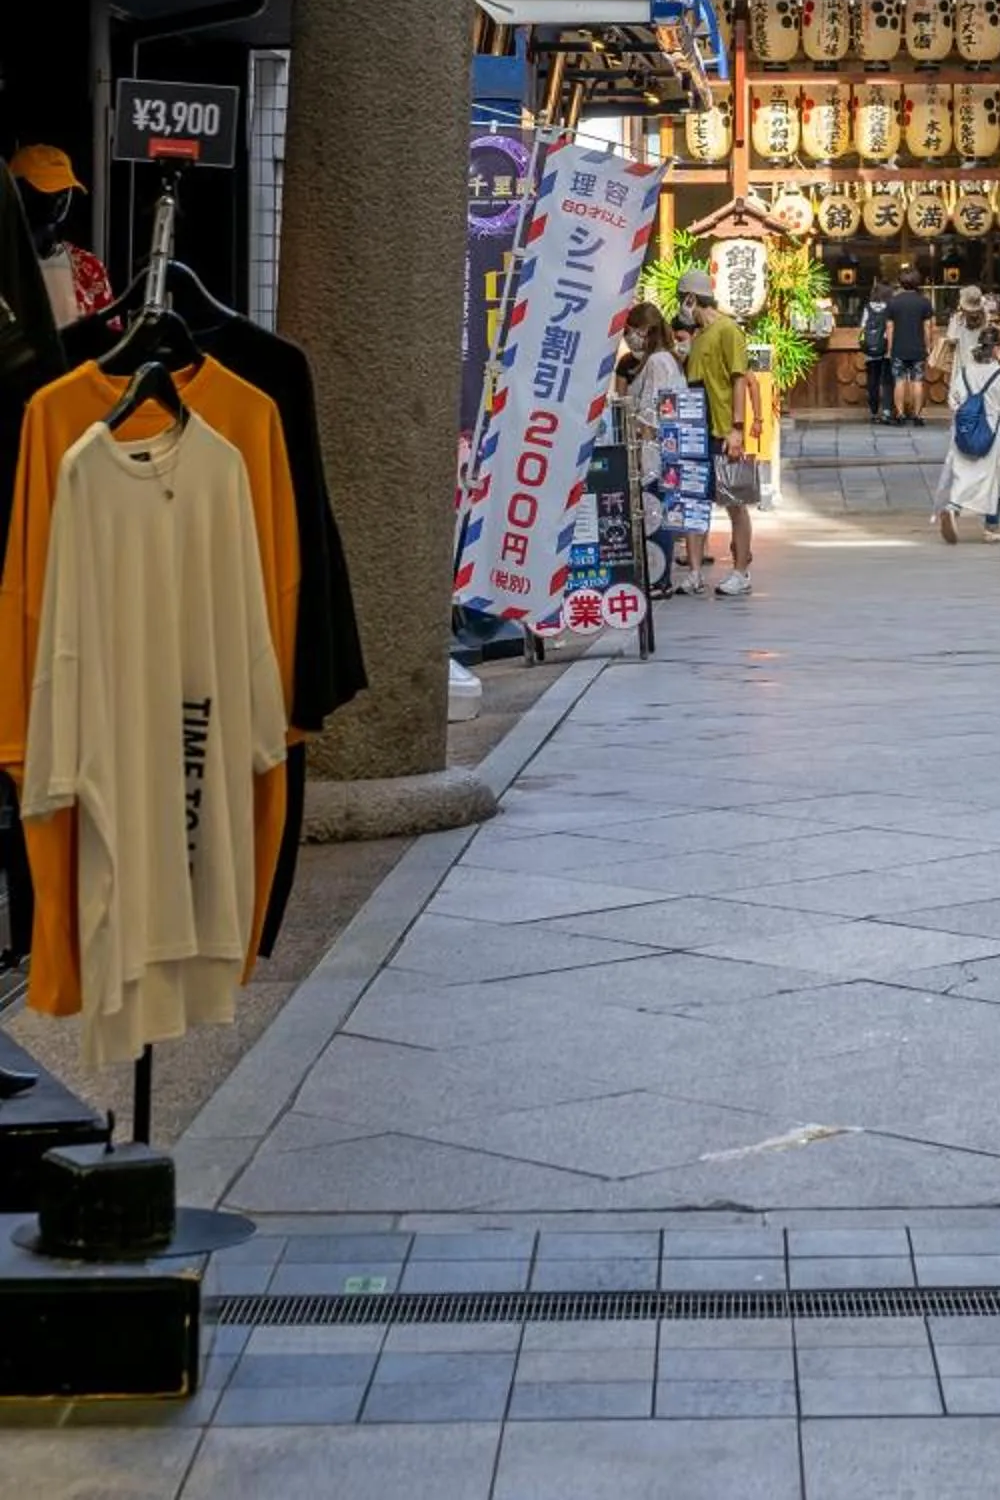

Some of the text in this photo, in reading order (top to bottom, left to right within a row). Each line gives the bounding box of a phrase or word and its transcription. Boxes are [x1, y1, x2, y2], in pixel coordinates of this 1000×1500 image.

[132, 97, 221, 136] ¥3,900
[569, 170, 629, 208] 理容
[724, 245, 757, 315] 錦天満宮
[181, 696, 212, 780] TIME
